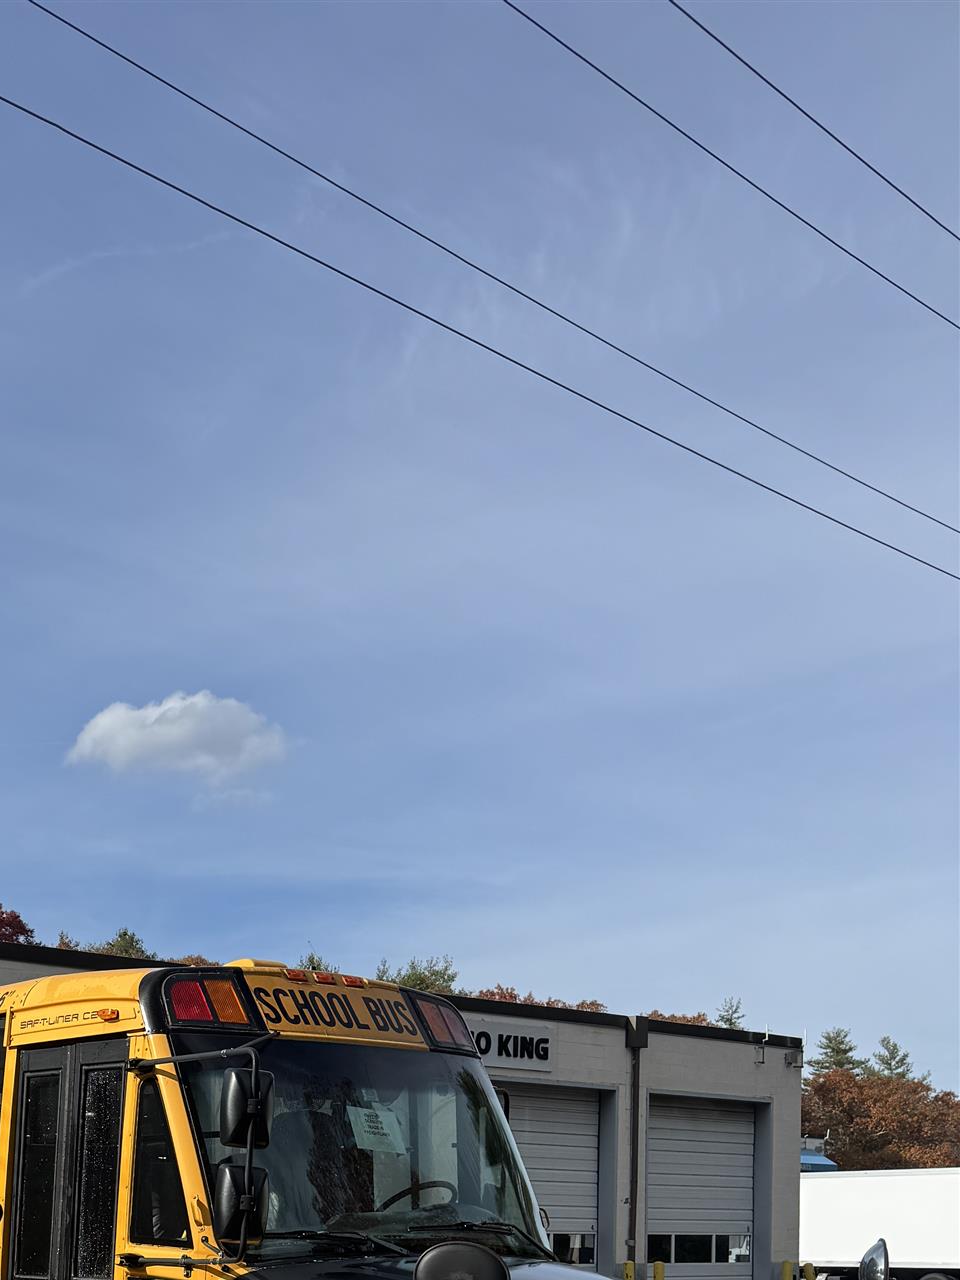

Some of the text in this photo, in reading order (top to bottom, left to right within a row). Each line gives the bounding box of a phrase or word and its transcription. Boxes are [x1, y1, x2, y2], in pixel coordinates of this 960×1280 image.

[253, 986, 418, 1036] SCHOOL BUS
[470, 1030, 550, 1061] O KING
